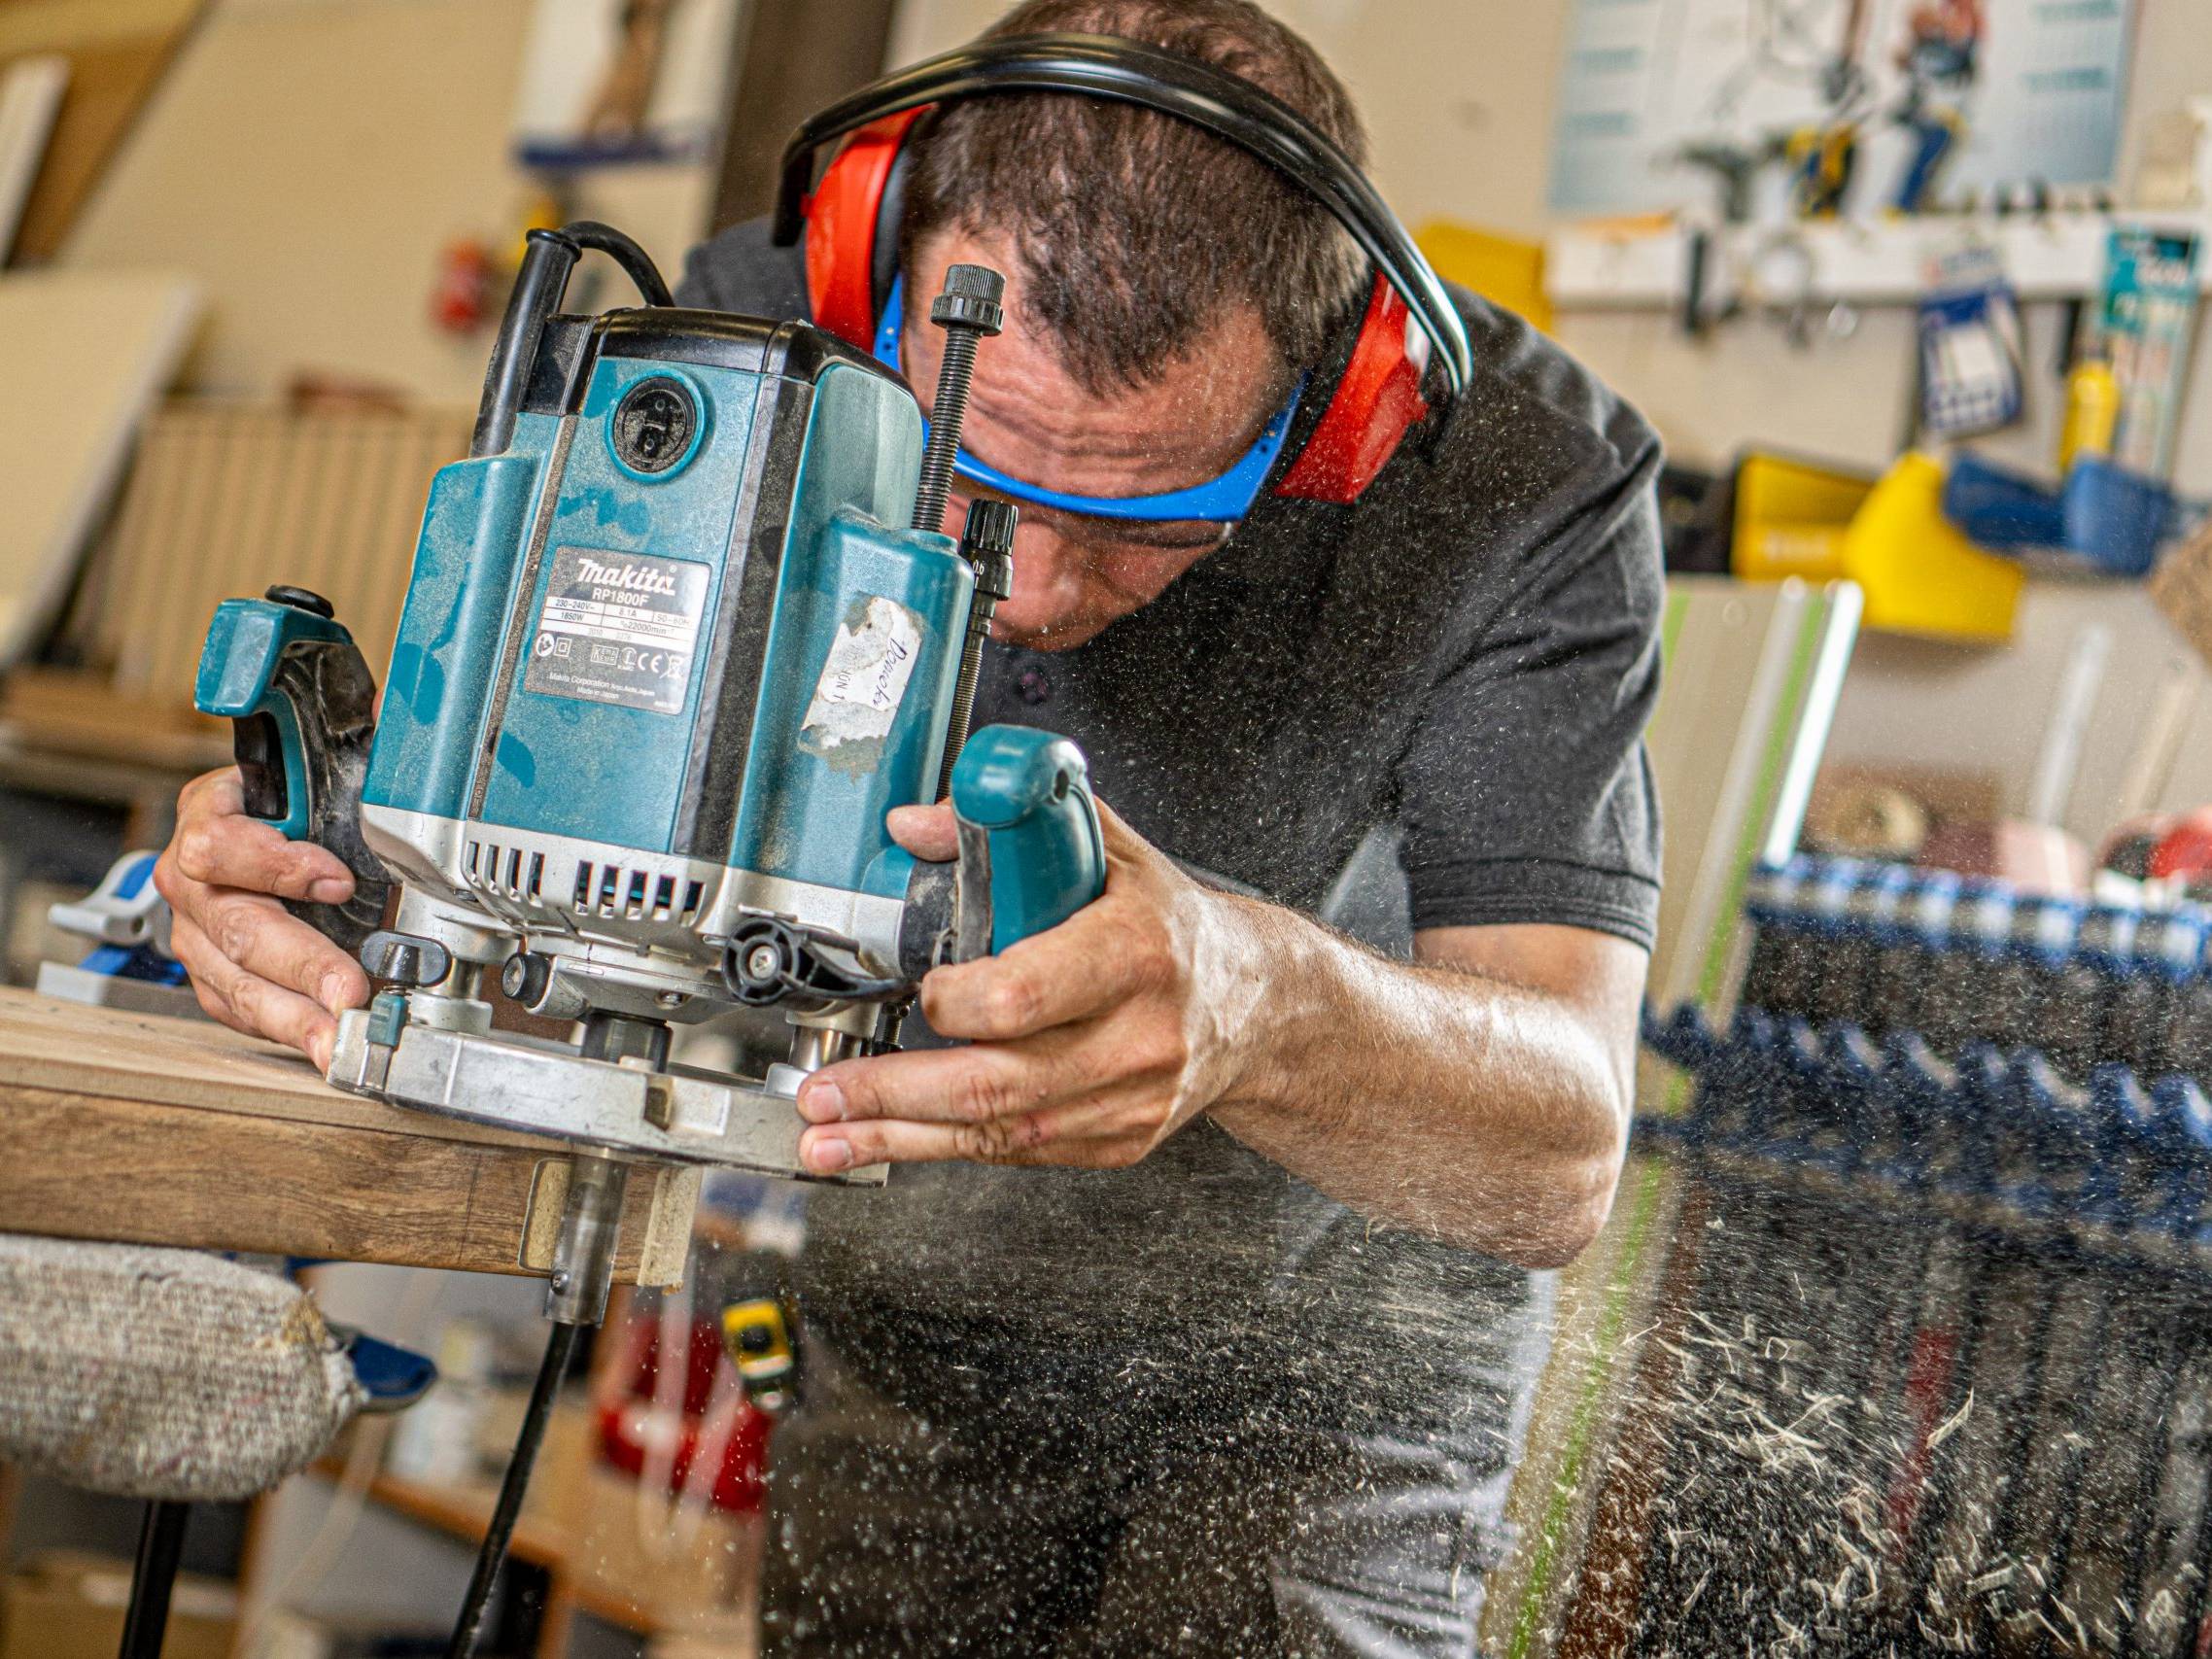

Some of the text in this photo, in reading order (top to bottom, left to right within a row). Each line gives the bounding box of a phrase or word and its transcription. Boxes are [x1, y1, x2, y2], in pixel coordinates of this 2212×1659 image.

[592, 587, 650, 606] RP1800F
[561, 611, 584, 622] 1850W
[549, 672, 570, 682] Makita
[571, 675, 610, 688] Corporation
